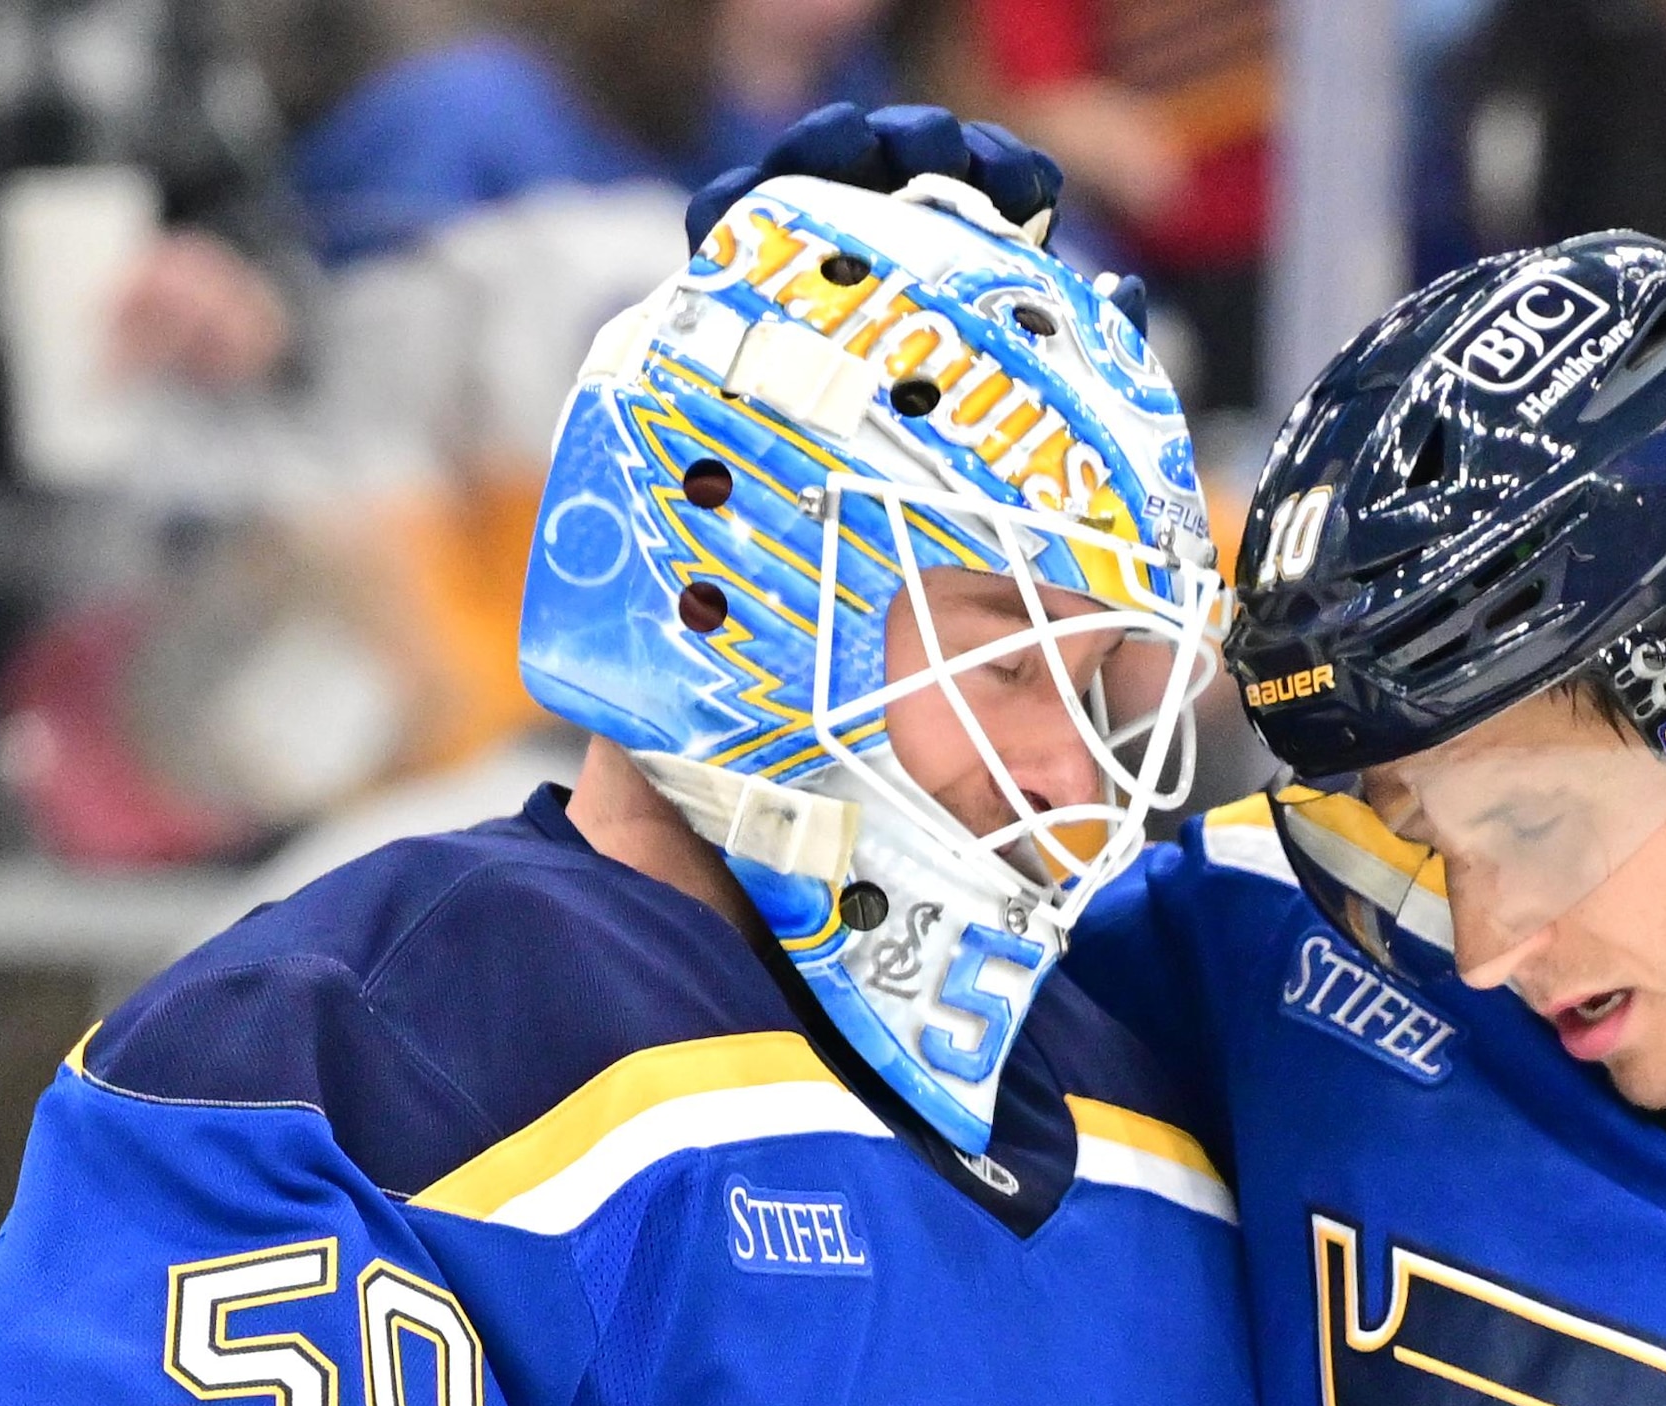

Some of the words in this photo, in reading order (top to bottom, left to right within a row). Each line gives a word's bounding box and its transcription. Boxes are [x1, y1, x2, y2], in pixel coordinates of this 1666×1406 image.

[1465, 286, 1575, 378] BJC
[1516, 318, 1634, 425] HealthCare
[1258, 485, 1333, 590] 10
[1284, 934, 1457, 1076] STIFEL
[731, 1185, 865, 1266] STIFEL
